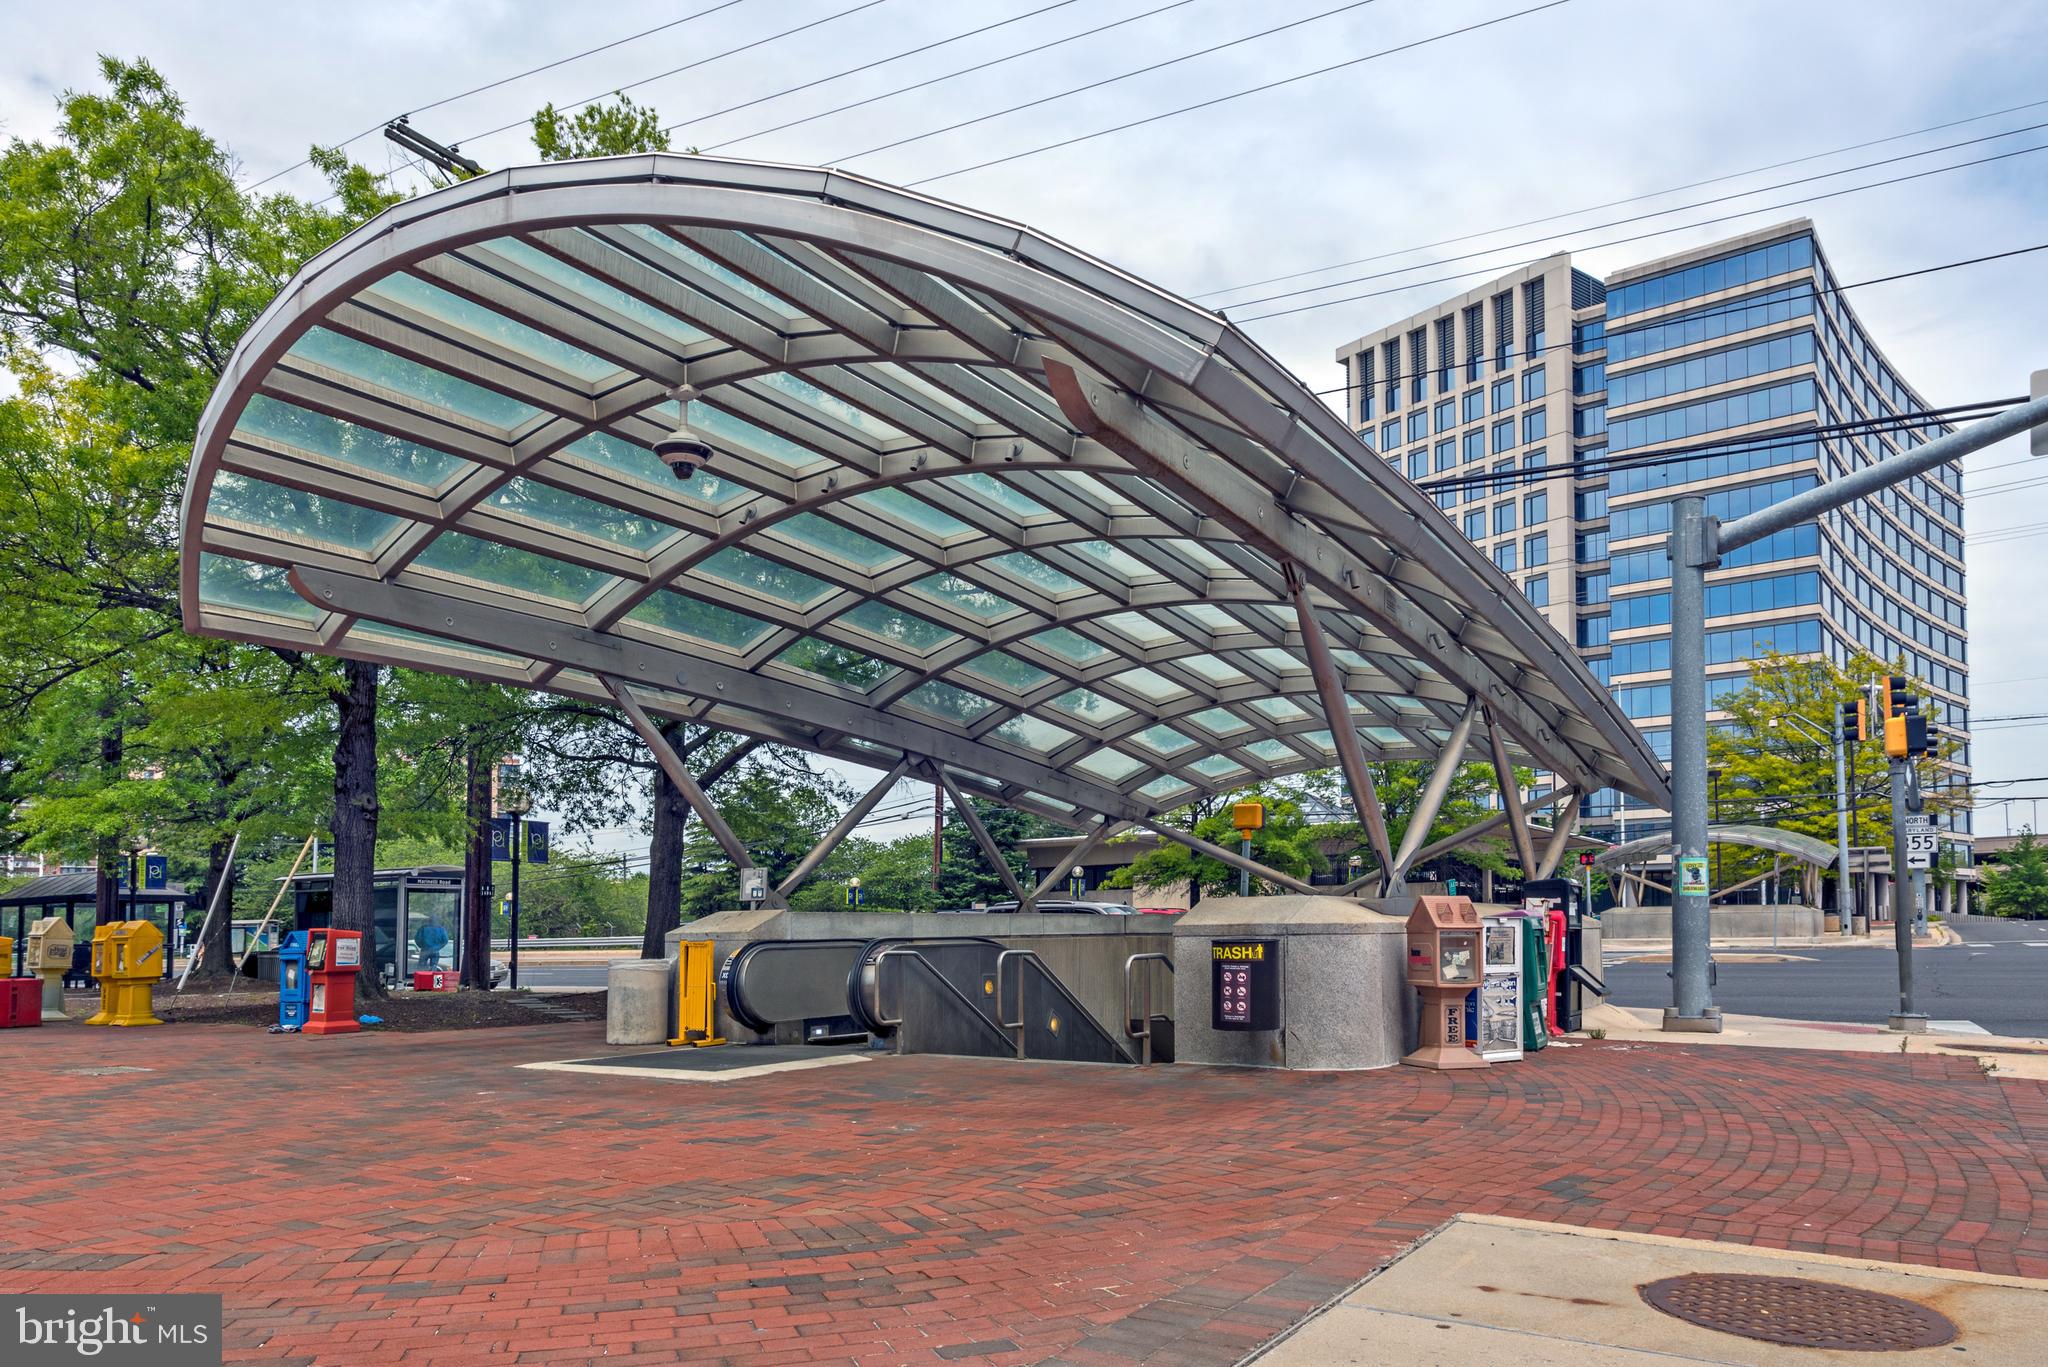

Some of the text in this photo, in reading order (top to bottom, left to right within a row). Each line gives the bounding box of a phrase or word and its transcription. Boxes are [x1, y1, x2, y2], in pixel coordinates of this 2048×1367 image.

[1905, 817, 1929, 825] NORTH
[1212, 946, 1252, 960] TRASH
[1447, 1008, 1459, 1043] FREE
